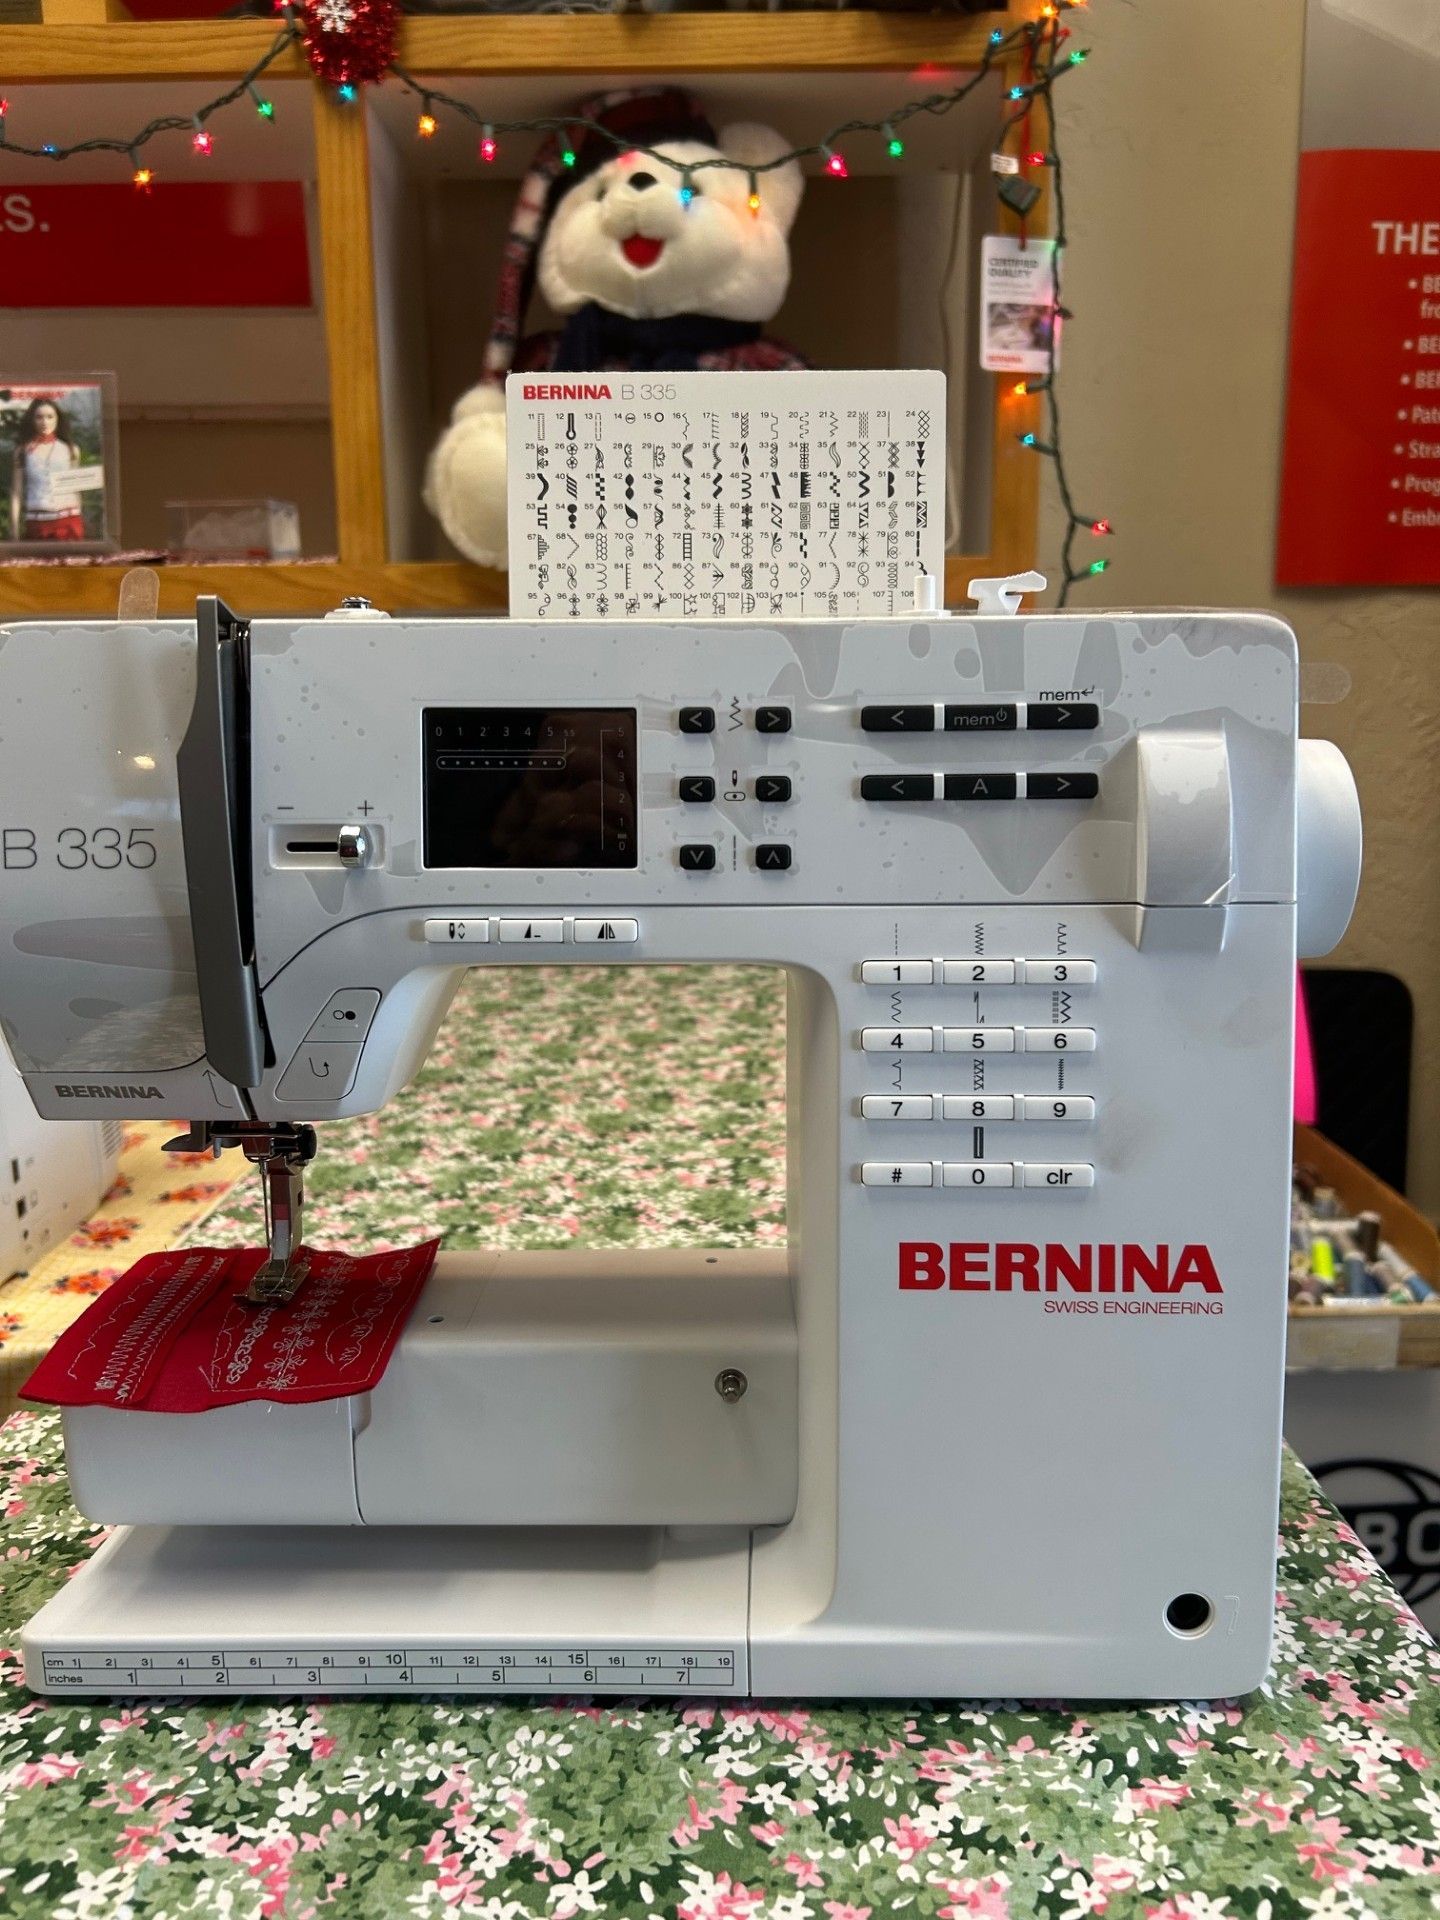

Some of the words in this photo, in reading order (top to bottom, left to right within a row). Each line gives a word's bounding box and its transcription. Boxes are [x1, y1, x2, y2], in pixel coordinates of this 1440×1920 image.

[0, 193, 50, 232] S.
[1371, 221, 1440, 254] THE
[523, 385, 612, 400] BERNINA
[622, 385, 634, 400] B
[640, 384, 677, 400] 335
[1040, 690, 1080, 700] mem
[954, 714, 994, 725] mem
[436, 727, 442, 736] 0
[459, 727, 462, 736] 1
[480, 727, 486, 736] 2
[504, 727, 509, 736] 3
[525, 727, 531, 736] 4
[548, 727, 553, 736] 5
[973, 779, 988, 794] A
[3, 829, 38, 869] B
[57, 828, 156, 869] 335
[894, 966, 901, 980] 1
[973, 966, 984, 981] 2
[1054, 965, 1067, 980] 3
[891, 1035, 903, 1048] 4
[972, 1034, 984, 1048] 5
[1054, 1034, 1067, 1048] 6
[55, 1085, 165, 1099] BERNINA
[891, 1103, 903, 1116] 7
[972, 1102, 984, 1116] 8
[1054, 1103, 1066, 1117] 9
[892, 1169, 902, 1181] #
[972, 1170, 984, 1184] 0
[1047, 1170, 1072, 1184] clr
[899, 1242, 1223, 1293] BERNINA
[1044, 1300, 1099, 1314] SWISS
[1103, 1301, 1223, 1314] ENGINEERING
[47, 1659, 64, 1667] cm
[141, 1658, 148, 1666] 3
[177, 1658, 184, 1666] 4
[211, 1656, 220, 1665] 5
[286, 1657, 293, 1665] 7
[323, 1657, 330, 1665] 8
[386, 1654, 402, 1664] 10
[463, 1656, 474, 1664] 12
[499, 1656, 511, 1664] 13
[536, 1656, 547, 1664] 14
[568, 1654, 584, 1664] 15
[681, 1657, 693, 1665] 18
[718, 1657, 730, 1665] 19
[49, 1674, 83, 1683] inches
[128, 1673, 134, 1683] 1
[216, 1672, 225, 1682] 2
[308, 1671, 317, 1682] 3
[400, 1671, 409, 1681] 4
[492, 1671, 500, 1681] 5
[584, 1671, 593, 1681] 6
[677, 1672, 686, 1681] 7
